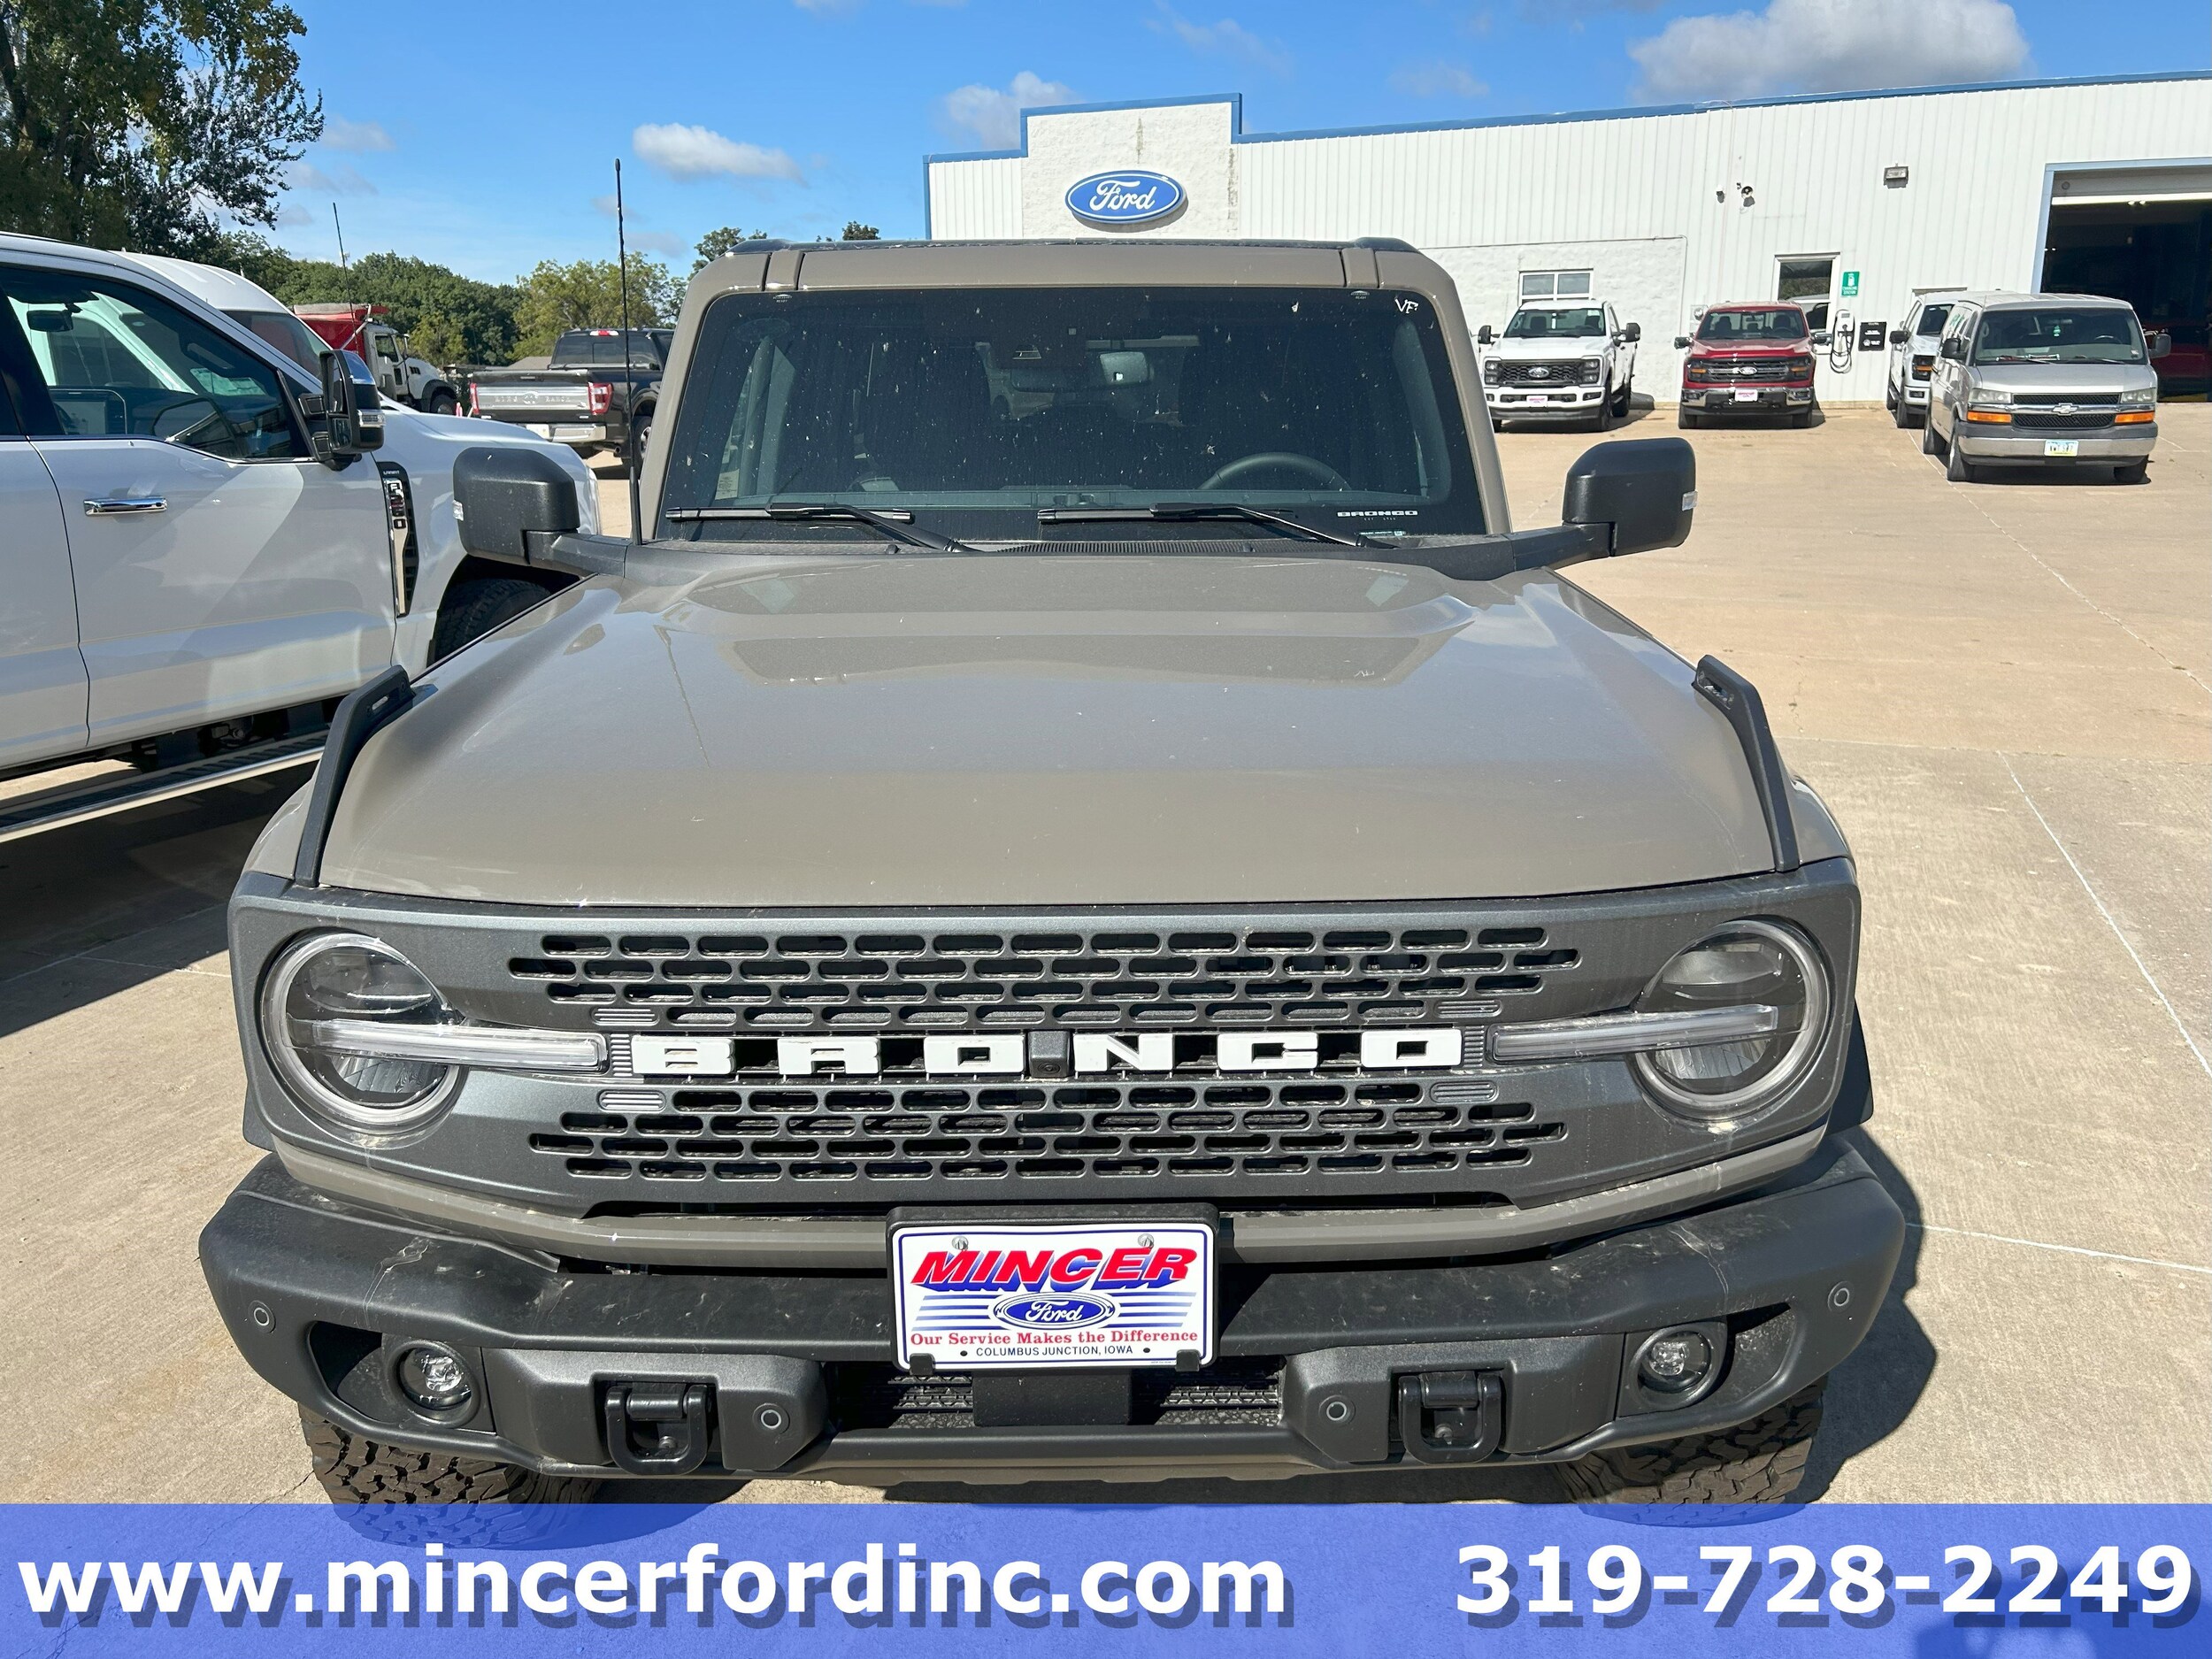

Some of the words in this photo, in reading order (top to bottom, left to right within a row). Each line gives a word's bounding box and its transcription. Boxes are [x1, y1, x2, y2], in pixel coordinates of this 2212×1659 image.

[1089, 180, 1157, 211] Ford
[631, 1029, 1462, 1075] BRONCO
[910, 1247, 1198, 1288] MINCER
[1025, 1300, 1085, 1322] Ford
[910, 1333, 942, 1346] Our
[949, 1333, 1011, 1345] Service
[1017, 1332, 1072, 1344] Makes
[1078, 1331, 1105, 1342] the
[1110, 1329, 1198, 1342] Difference
[976, 1346, 1039, 1357] COLUMBUS
[1041, 1346, 1102, 1356] JUNCTION,
[1104, 1345, 1133, 1355] IOWA
